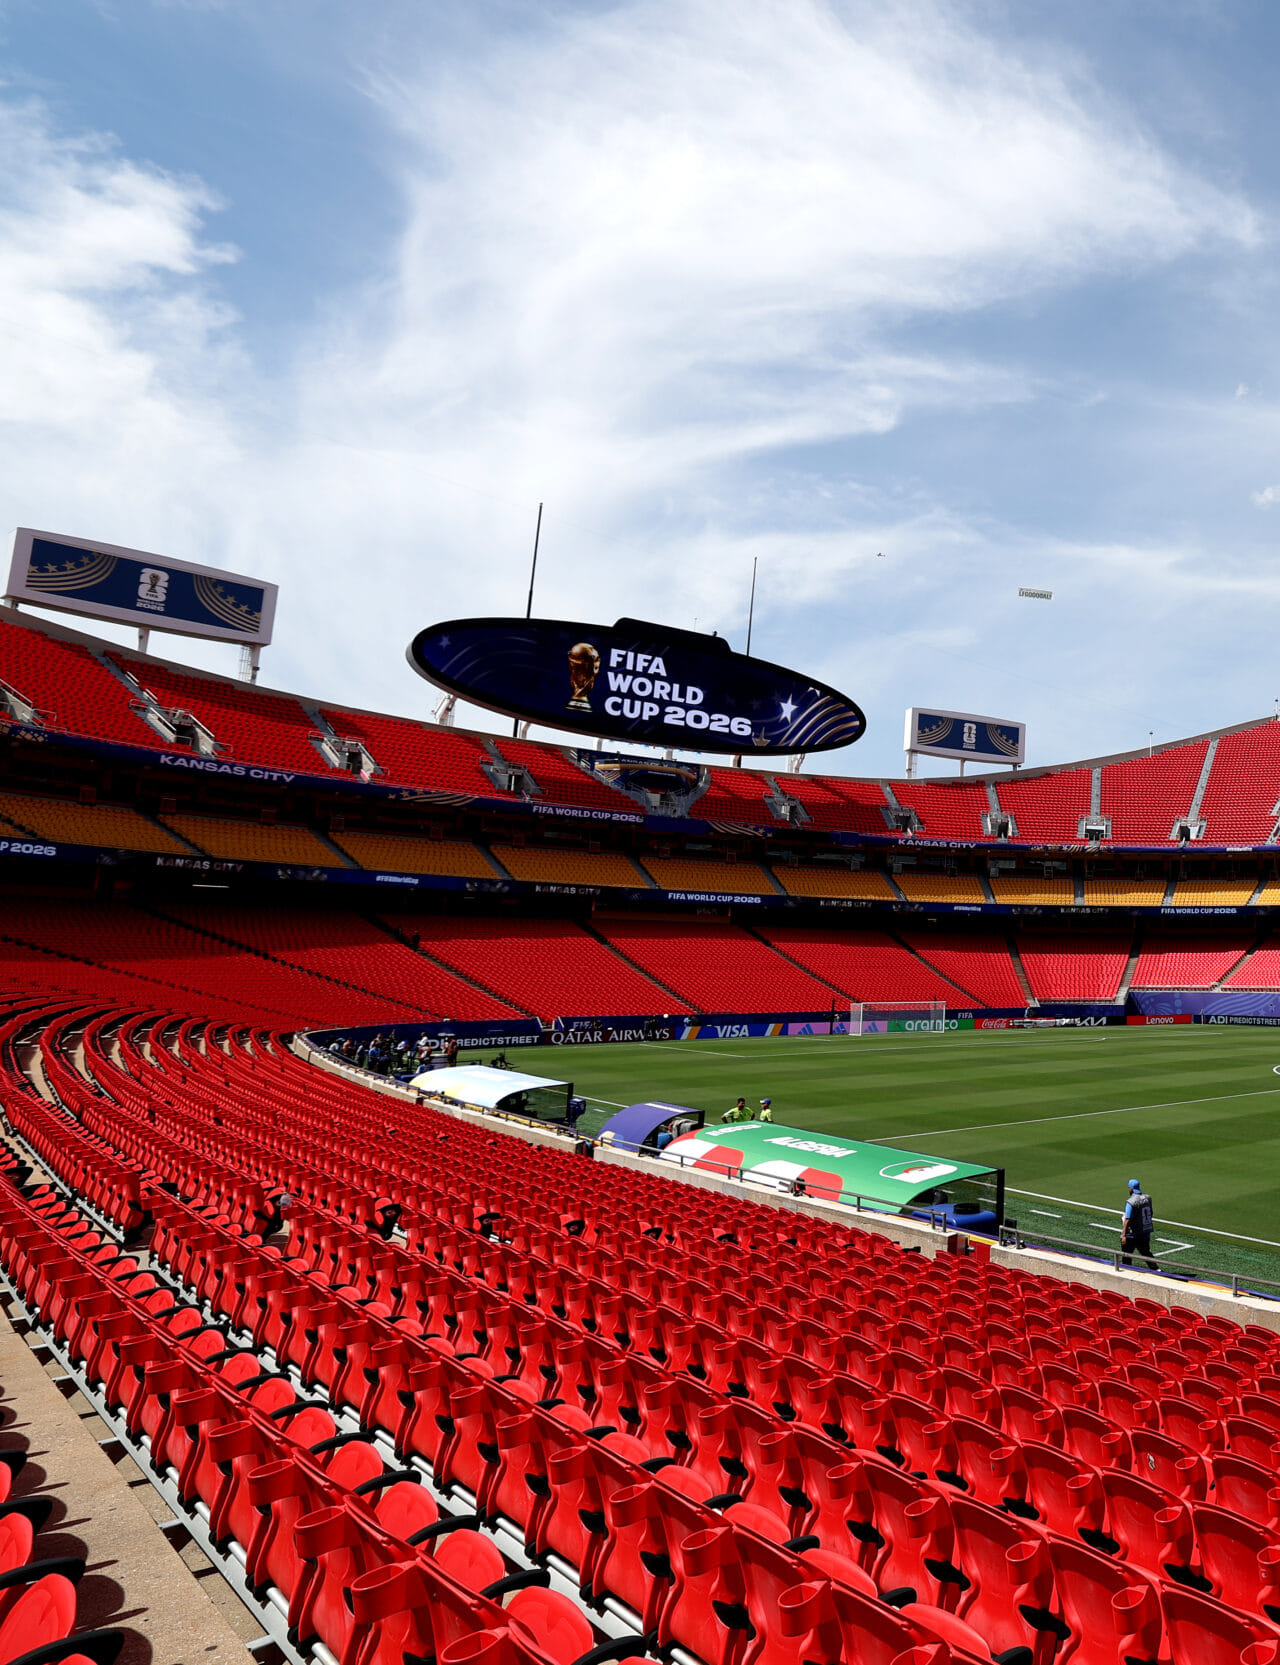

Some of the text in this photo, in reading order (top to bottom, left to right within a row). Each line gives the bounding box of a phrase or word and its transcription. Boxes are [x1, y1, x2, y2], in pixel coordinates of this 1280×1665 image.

[610, 648, 667, 677] FIFA
[607, 672, 704, 705] WORLD
[604, 696, 752, 736] CUP 2026
[160, 754, 296, 784] KANSAS CITY
[532, 805, 644, 824] FIFA WORLD CUP 2026
[10, 842, 57, 857] 2026
[898, 838, 976, 849] KANSAS CITY
[156, 856, 244, 873] KANSAS CITY
[535, 885, 602, 896] KANSAS CITY
[668, 892, 761, 904] FIFA WORLD CUP 2026
[820, 900, 852, 908] KANSAS
[905, 1018, 958, 1031] aramco
[1146, 1016, 1174, 1025] Lenovo
[1209, 1015, 1280, 1026] ADI PREDICTSTREET
[551, 1031, 602, 1046] QATAR
[716, 1025, 750, 1038] VISA
[456, 1035, 540, 1047] REDICTSTREET
[762, 1136, 858, 1158] ALGERIA
